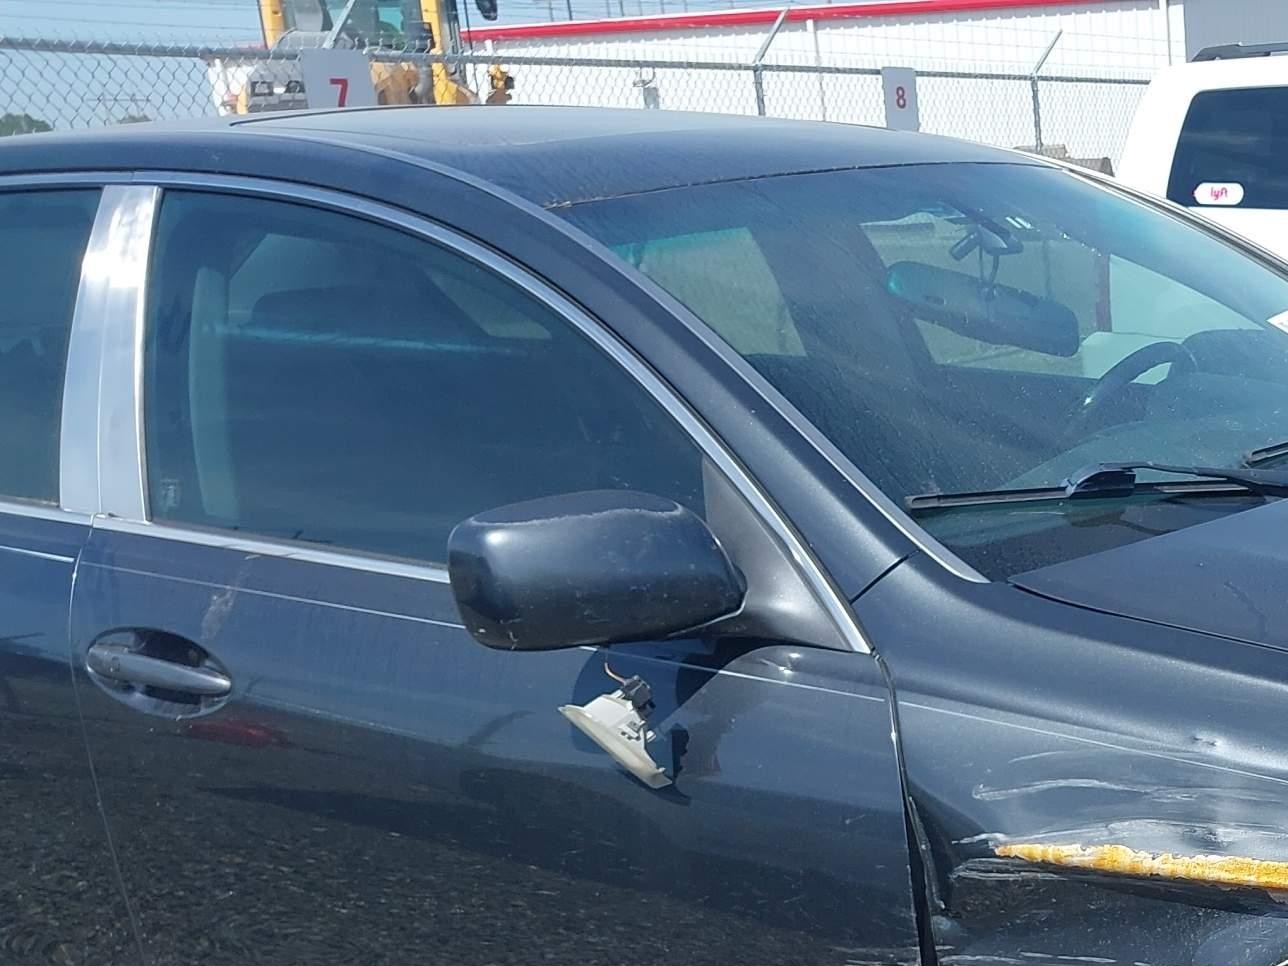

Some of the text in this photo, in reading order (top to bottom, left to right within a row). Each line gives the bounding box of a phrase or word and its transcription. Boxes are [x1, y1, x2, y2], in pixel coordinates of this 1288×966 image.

[329, 78, 349, 108] 7
[895, 86, 906, 109] 8
[1210, 186, 1228, 201] lyft
